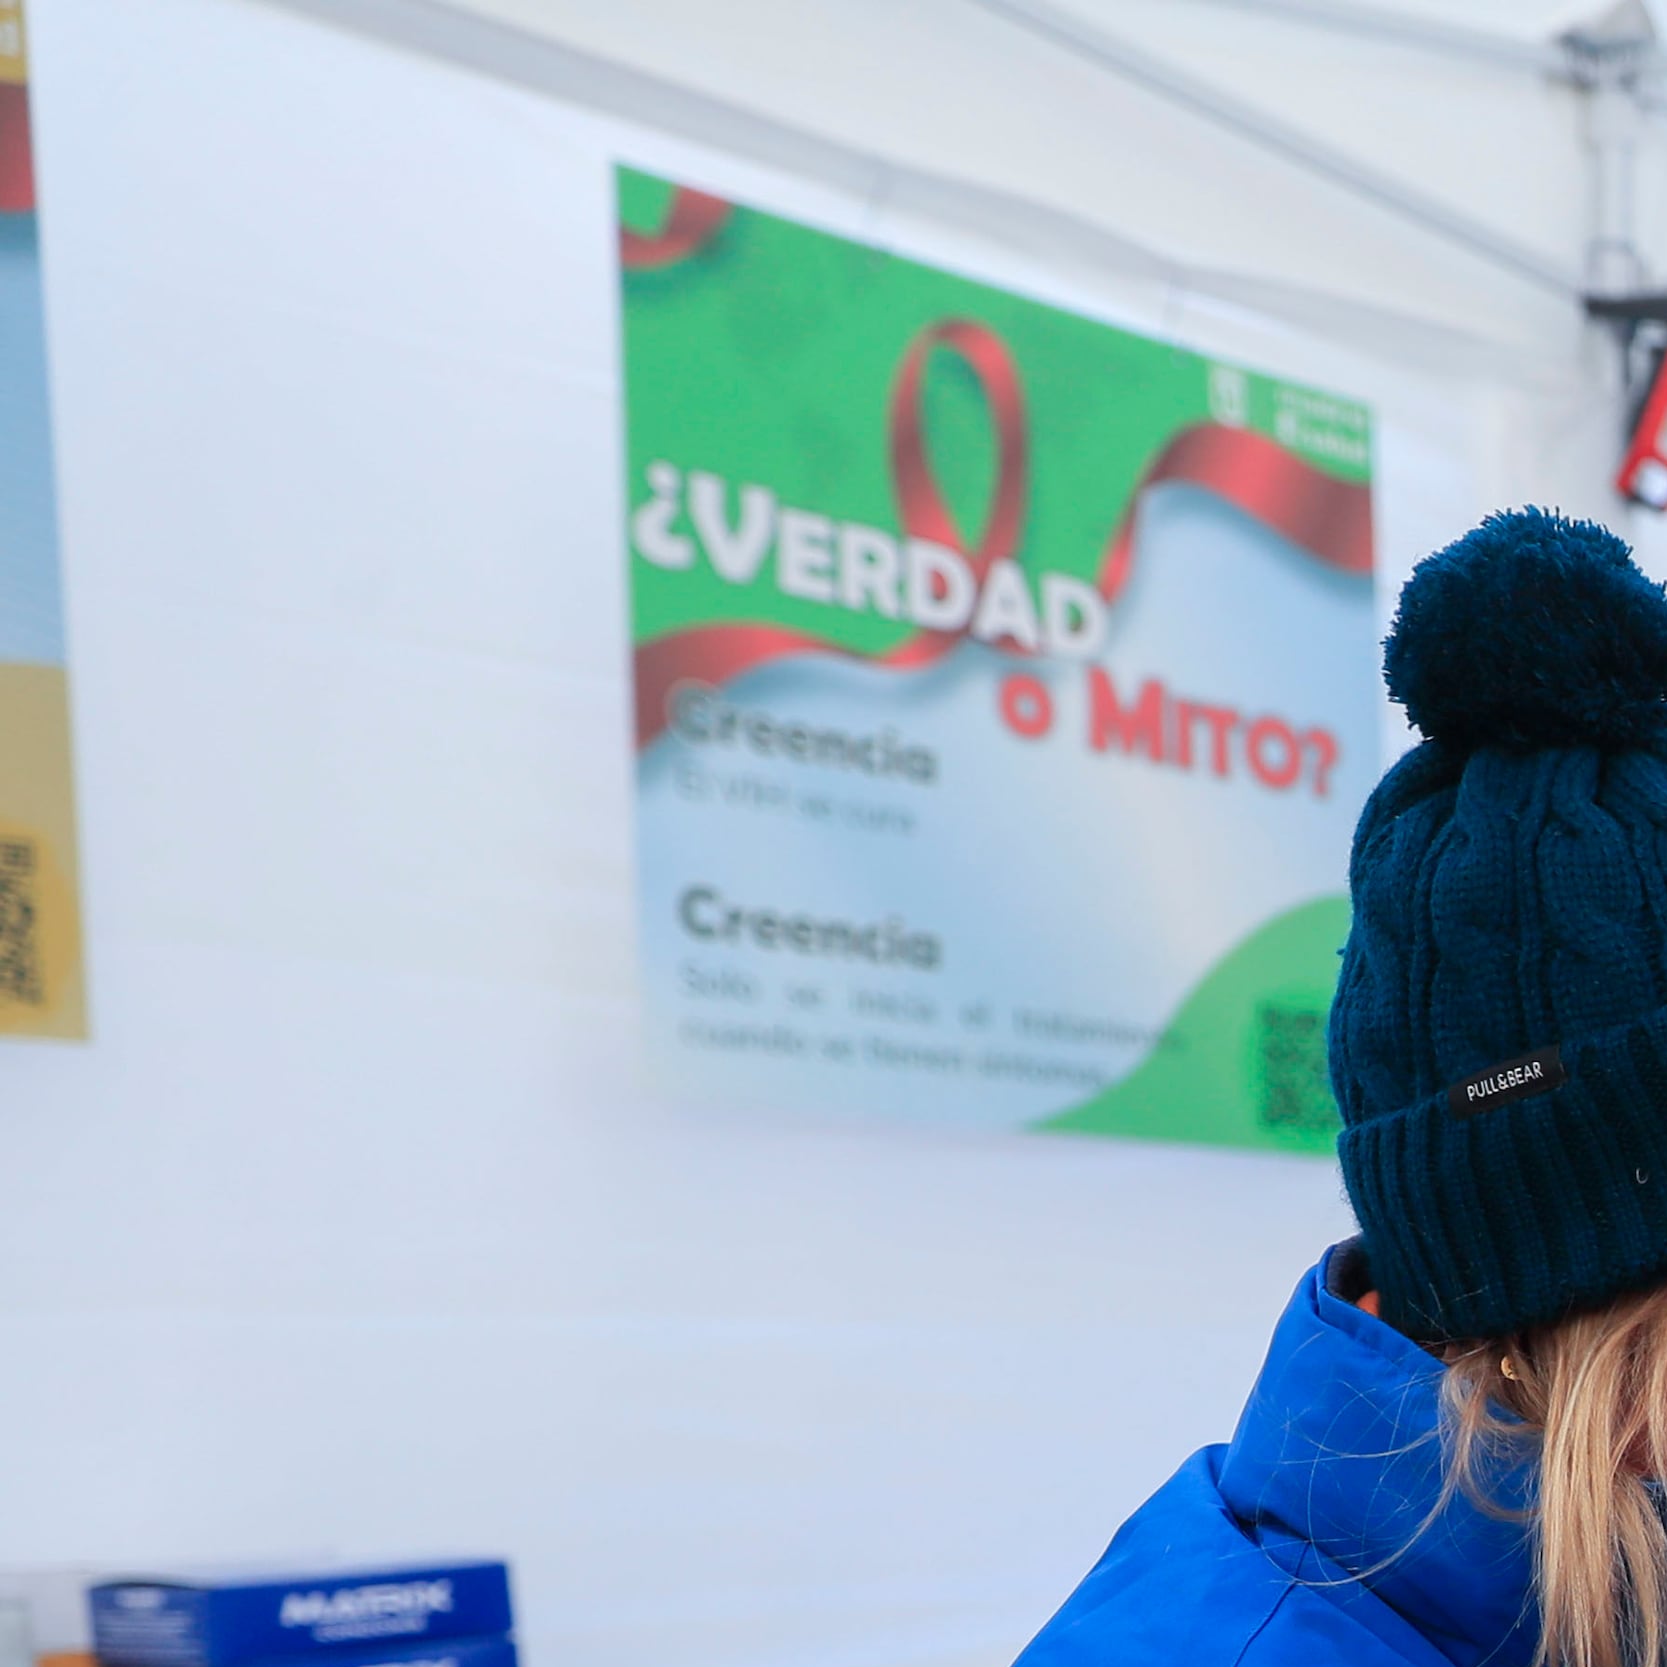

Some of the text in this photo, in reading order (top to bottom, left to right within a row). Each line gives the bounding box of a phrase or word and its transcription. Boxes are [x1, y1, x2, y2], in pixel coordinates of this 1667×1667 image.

[631, 460, 1110, 658] ¿VERDAD
[667, 678, 942, 788] Creencia
[1086, 660, 1338, 801] MITO?
[675, 881, 946, 973] Creencia
[1466, 1061, 1544, 1102] PULL&BEAR
[279, 1578, 454, 1628] MATRIX
